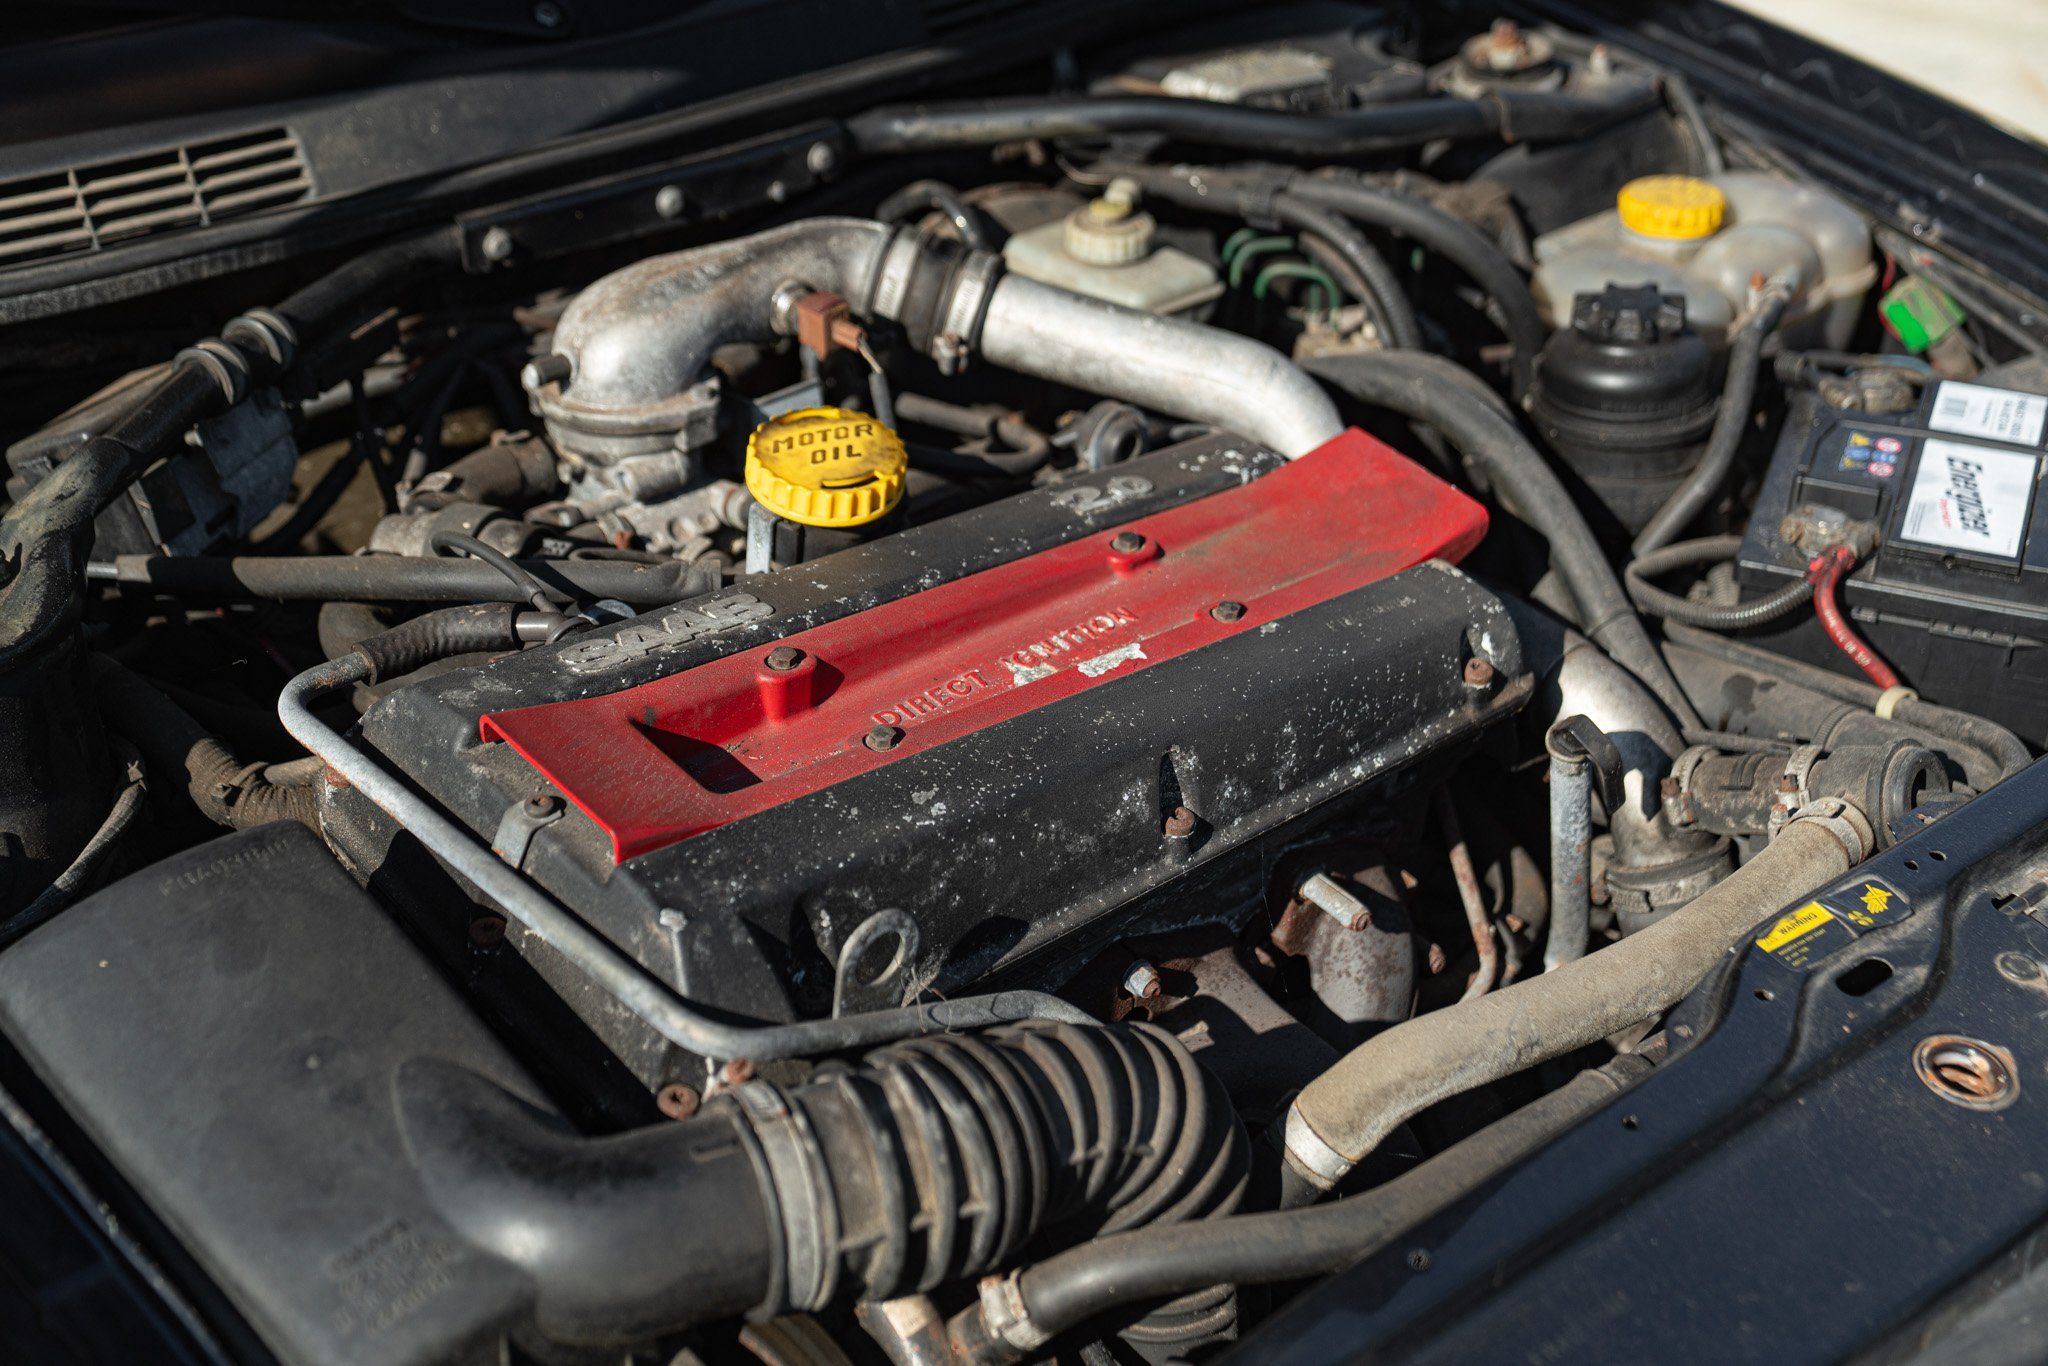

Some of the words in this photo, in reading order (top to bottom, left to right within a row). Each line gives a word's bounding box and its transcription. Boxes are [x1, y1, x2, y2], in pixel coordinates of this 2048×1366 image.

[773, 423, 873, 454] MOTOR
[811, 445, 861, 464] OIL
[557, 593, 775, 674] SAAB
[872, 669, 989, 727] DIRECT
[1000, 607, 1138, 673] IGNITION
[1780, 913, 1818, 935] WARNING
